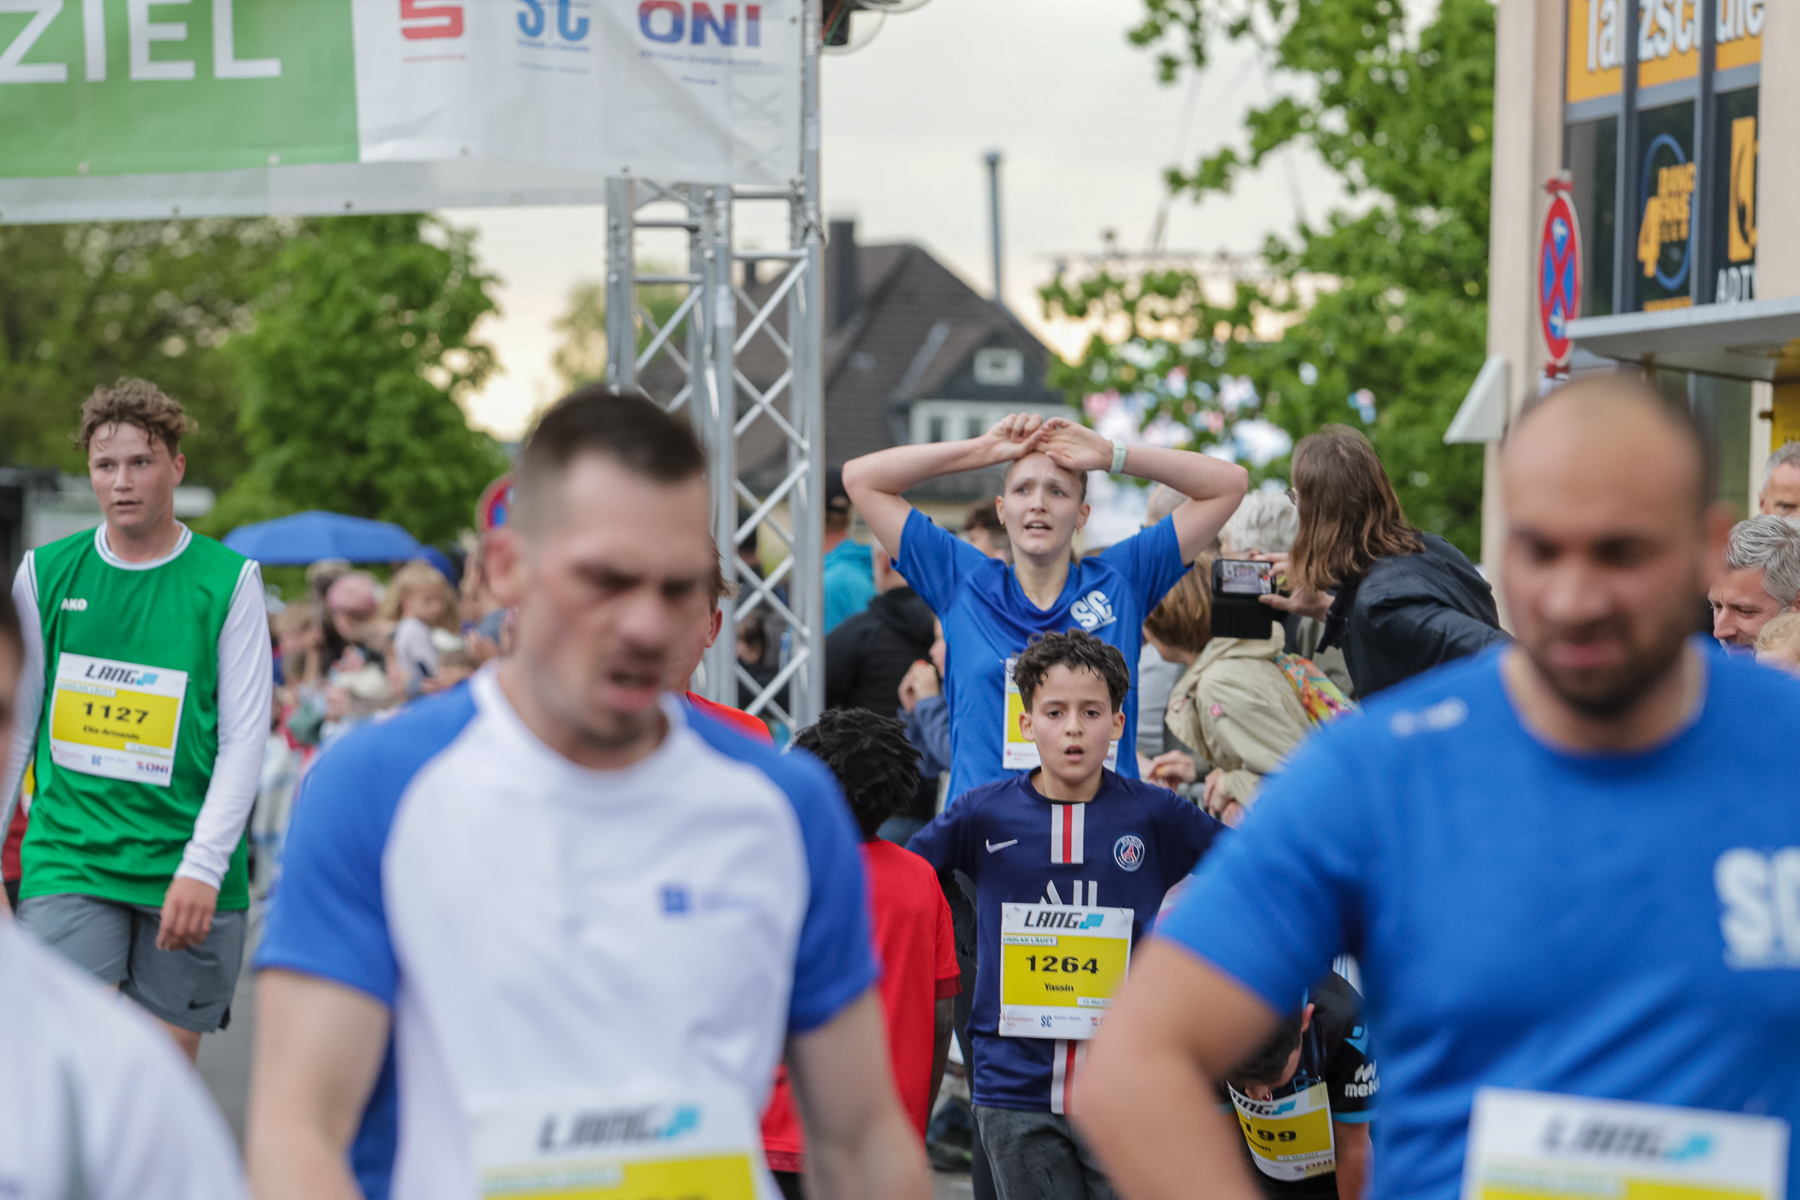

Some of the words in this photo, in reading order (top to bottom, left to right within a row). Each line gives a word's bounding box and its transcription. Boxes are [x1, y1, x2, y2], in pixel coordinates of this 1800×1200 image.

[637, 0, 763, 48] ONI
[0, 0, 282, 84] ZIEL
[84, 663, 140, 685] LANG
[83, 701, 149, 725] 1127
[1023, 910, 1082, 930] LANG
[1026, 954, 1099, 975] 1264
[1044, 982, 1075, 993] Yassin
